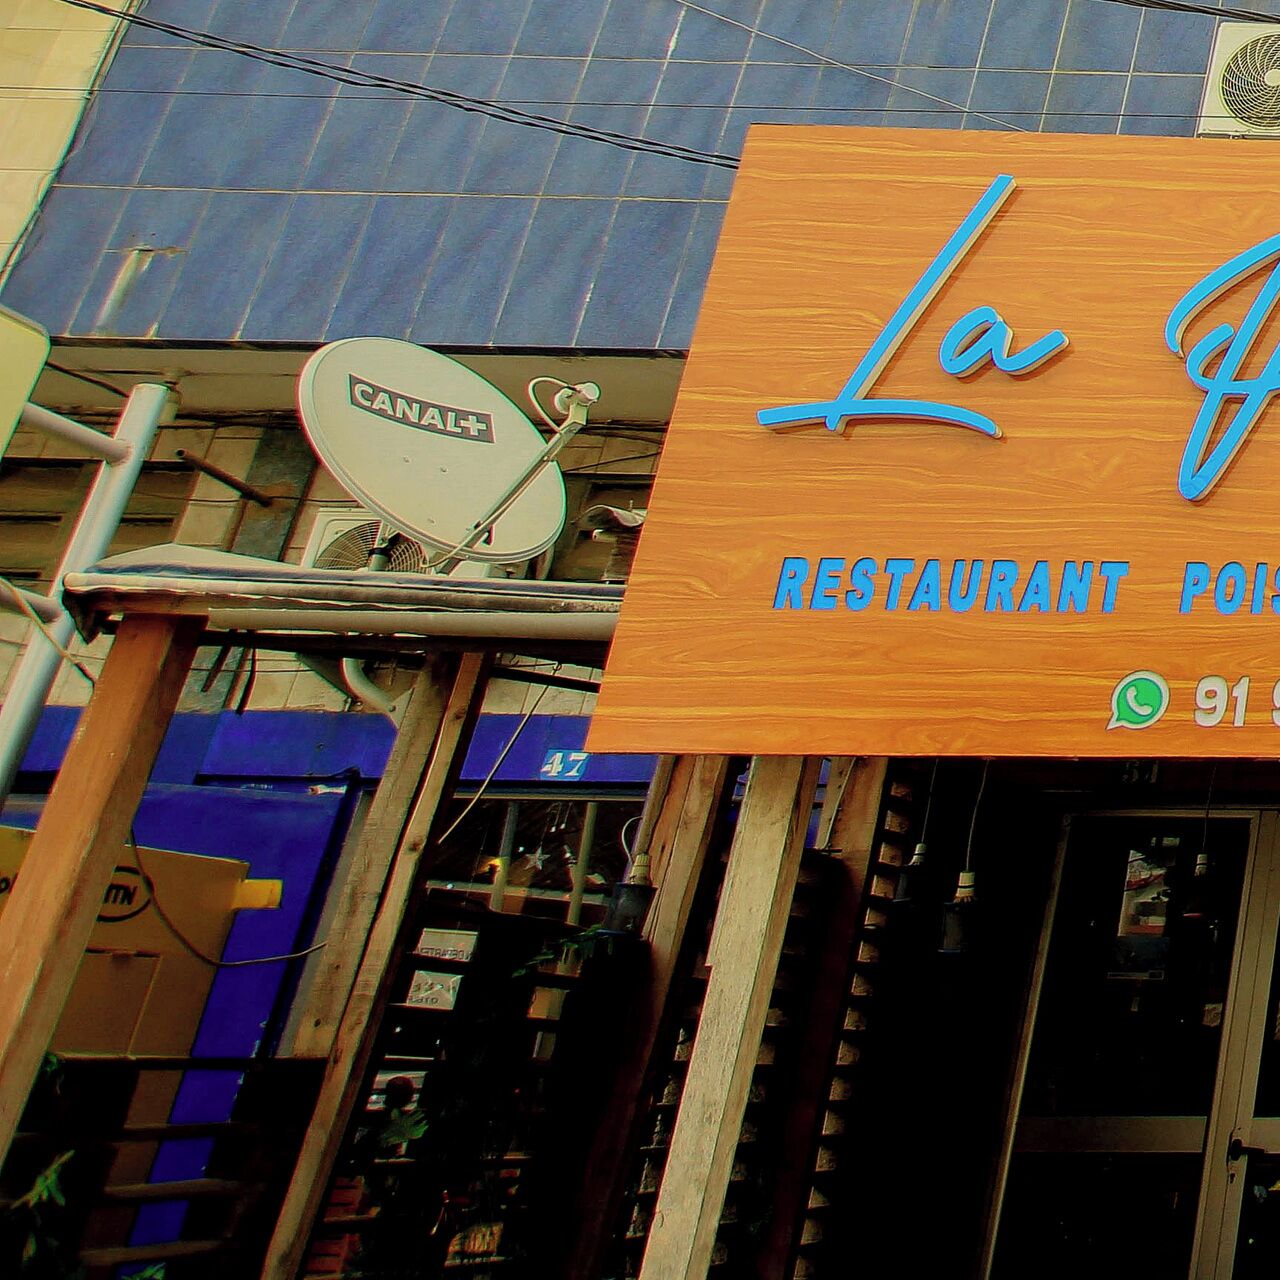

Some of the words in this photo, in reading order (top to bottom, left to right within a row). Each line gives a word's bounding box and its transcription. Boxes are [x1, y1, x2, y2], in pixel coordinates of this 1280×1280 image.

[756, 173, 1070, 439] La
[353, 382, 488, 438] CANAL+
[772, 556, 1130, 614] RESTAURANT
[1193, 674, 1250, 728] 91
[541, 752, 589, 777] 47
